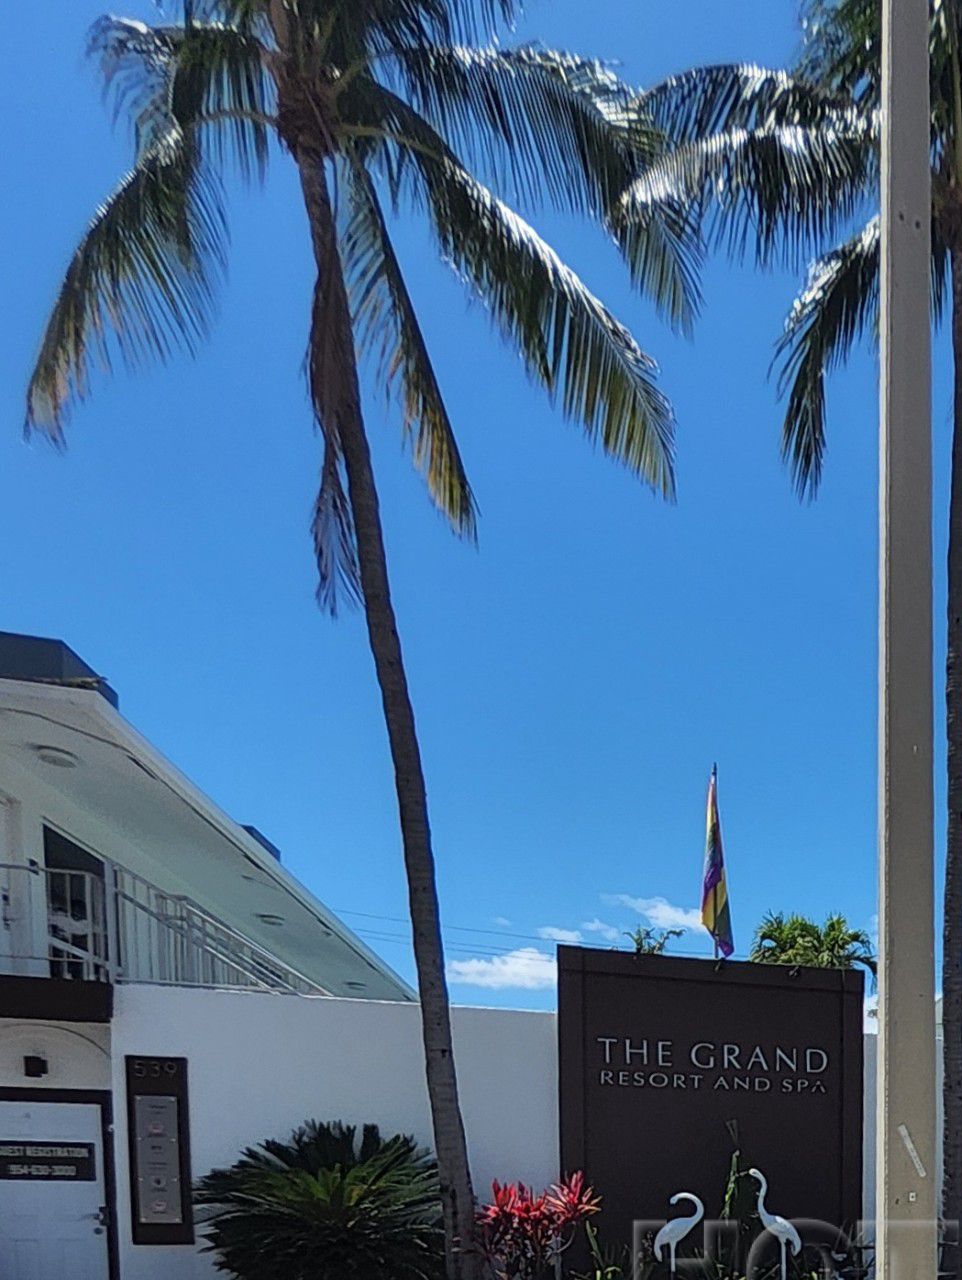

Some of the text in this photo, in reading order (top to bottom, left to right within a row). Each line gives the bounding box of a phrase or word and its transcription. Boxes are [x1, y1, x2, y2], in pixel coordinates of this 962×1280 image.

[597, 1038, 828, 1073] THE GRAND
[134, 1060, 177, 1078] 539
[600, 1071, 826, 1093] RESORT AND SPA
